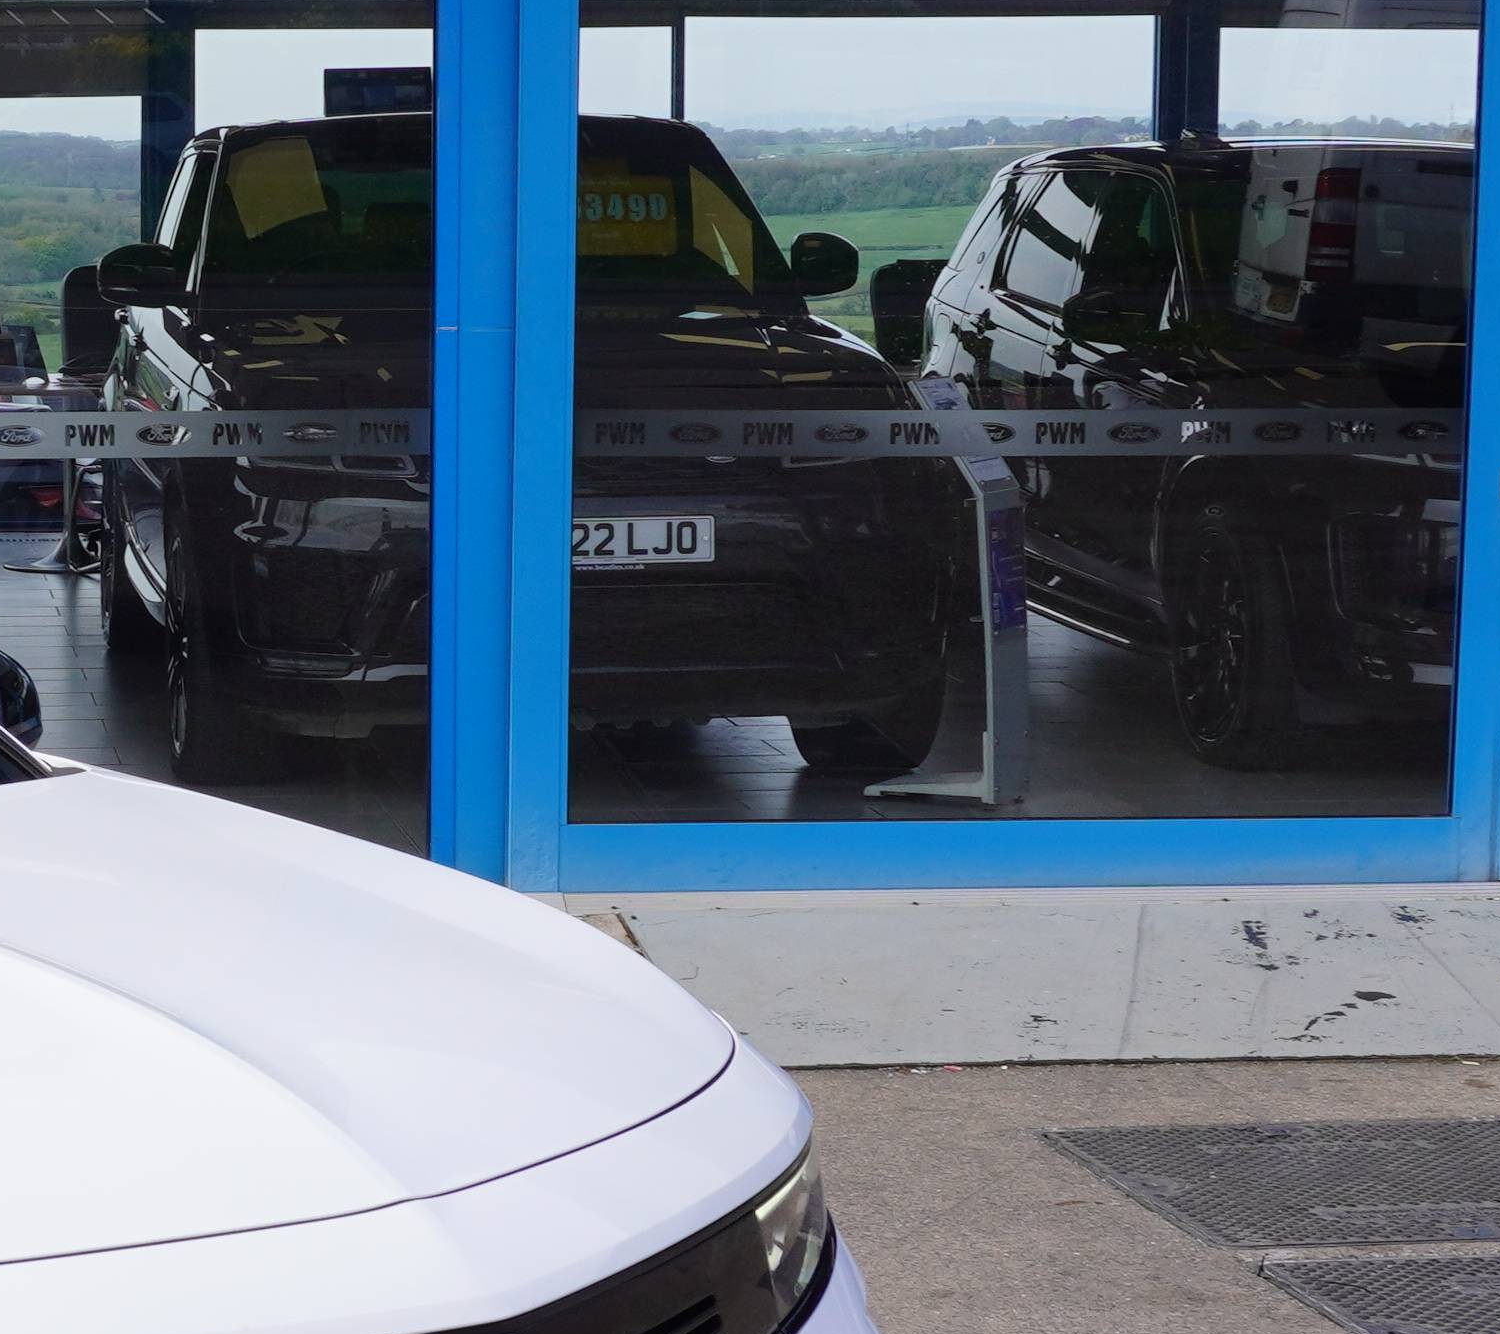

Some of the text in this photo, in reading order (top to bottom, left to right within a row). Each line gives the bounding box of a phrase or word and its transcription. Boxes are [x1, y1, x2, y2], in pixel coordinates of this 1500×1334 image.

[64, 423, 116, 447] PWM
[595, 422, 646, 445] PWM
[743, 422, 795, 445] PWM
[888, 421, 940, 445] PWM
[1035, 421, 1087, 444] PWM
[627, 521, 698, 556] LJO
